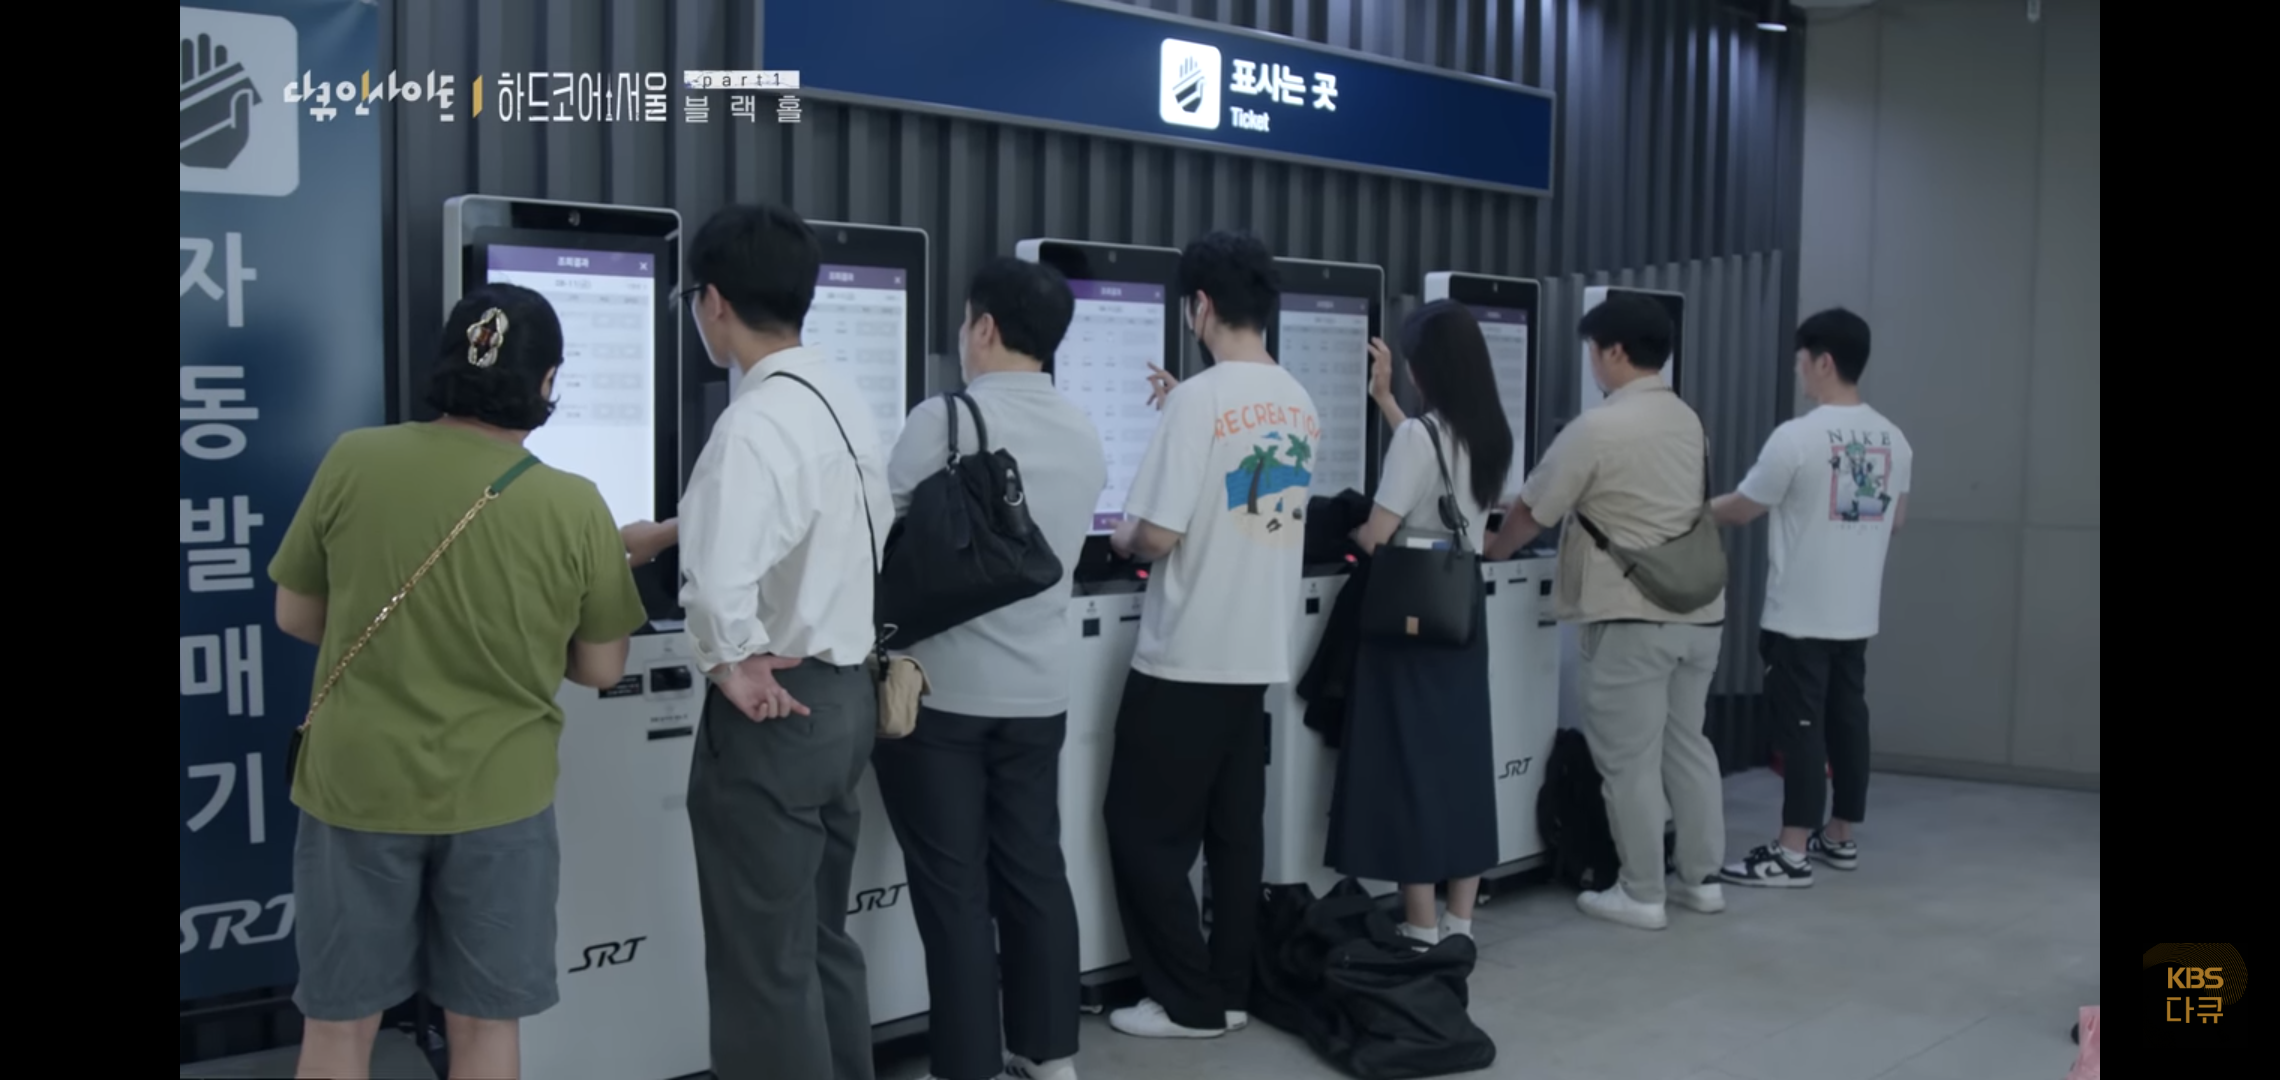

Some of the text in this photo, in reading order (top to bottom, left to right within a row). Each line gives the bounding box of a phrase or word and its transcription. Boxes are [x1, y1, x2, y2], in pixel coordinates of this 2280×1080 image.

[1229, 58, 1339, 112] 표사는 곳
[1229, 106, 1270, 132] Ticket
[1827, 429, 1891, 446] NIKE
[1498, 756, 1533, 779] SRT
[846, 882, 908, 915] SRT
[568, 935, 647, 973] SRT
